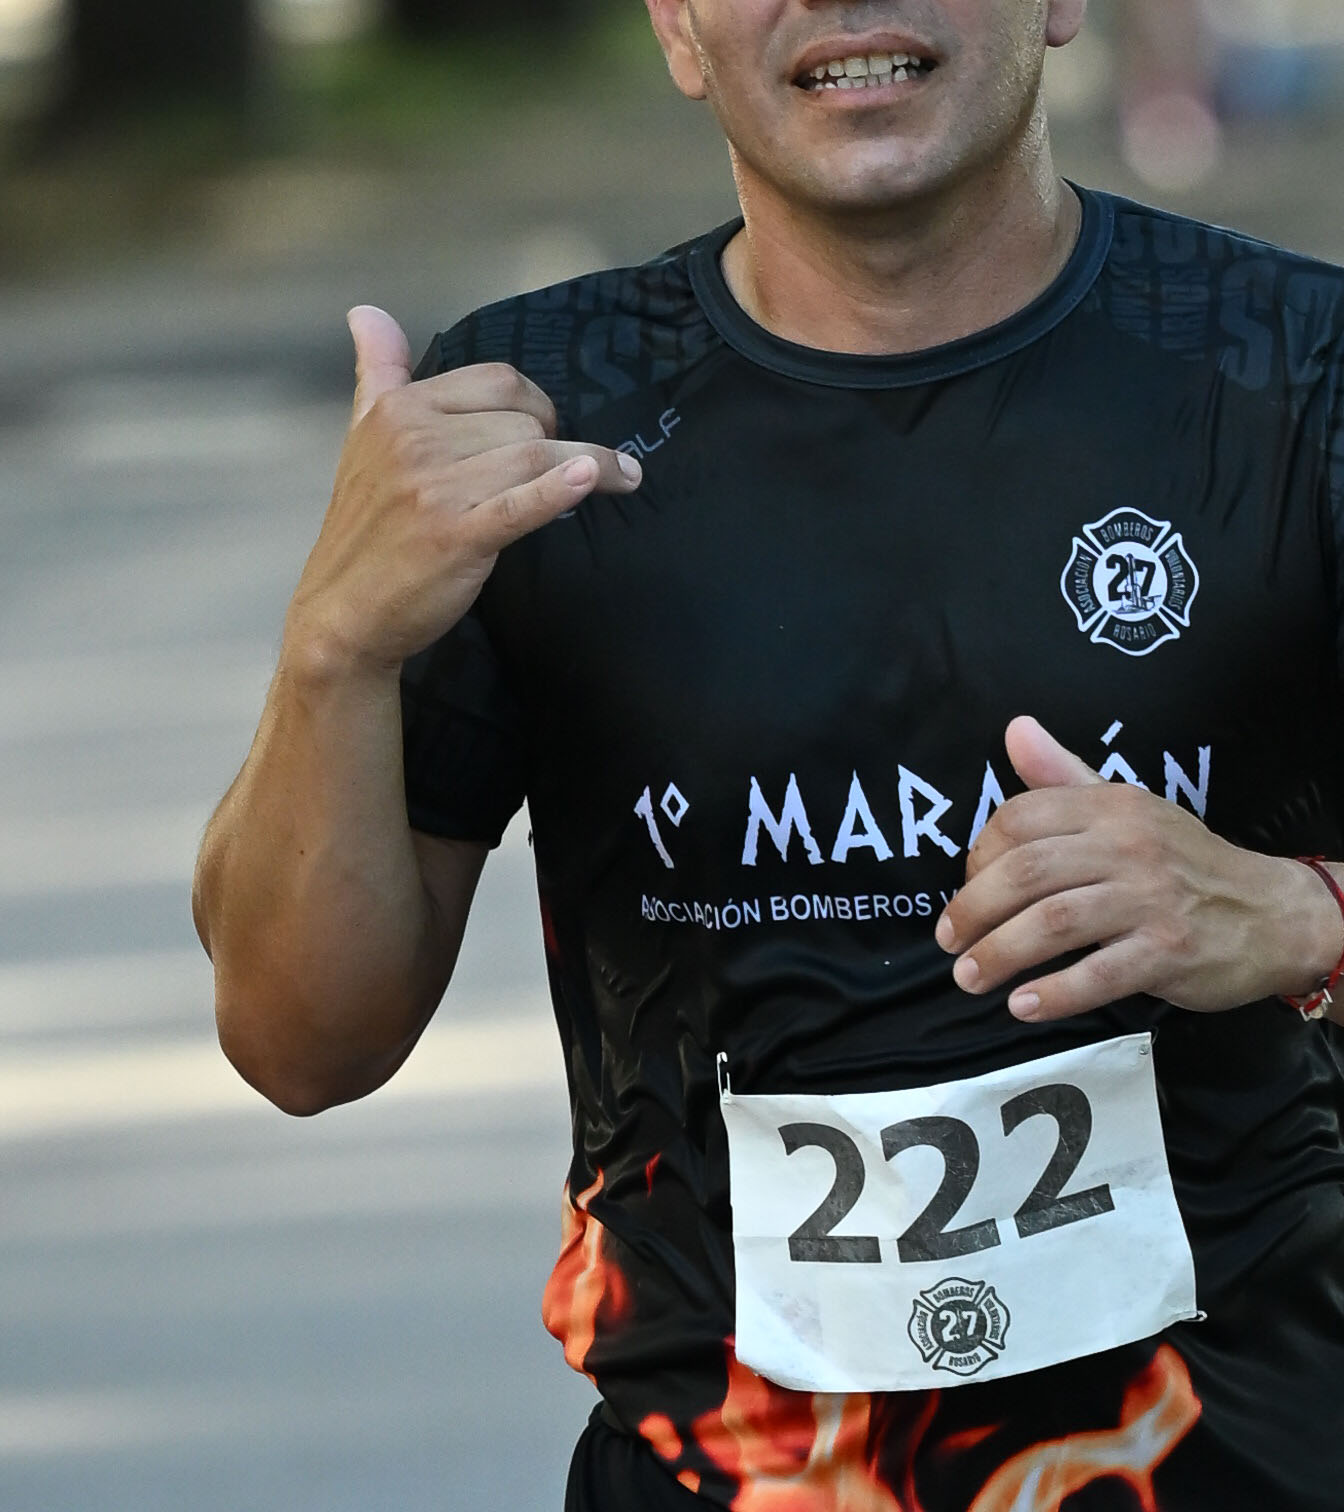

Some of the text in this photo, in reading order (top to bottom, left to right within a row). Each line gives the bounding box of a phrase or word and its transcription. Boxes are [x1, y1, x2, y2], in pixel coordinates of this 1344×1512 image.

[1100, 521, 1154, 543] BOMBEROS
[1105, 553, 1157, 602] 27
[1164, 548, 1188, 611] VOLUNTARIOS
[1113, 623, 1157, 642] ROSARIO
[741, 719, 1213, 866] MARAÓN
[641, 893, 762, 931] ASOCIACIÓN
[770, 891, 933, 923] BOMBEROS
[777, 1083, 1116, 1264] 222
[939, 1309, 978, 1343] 27
